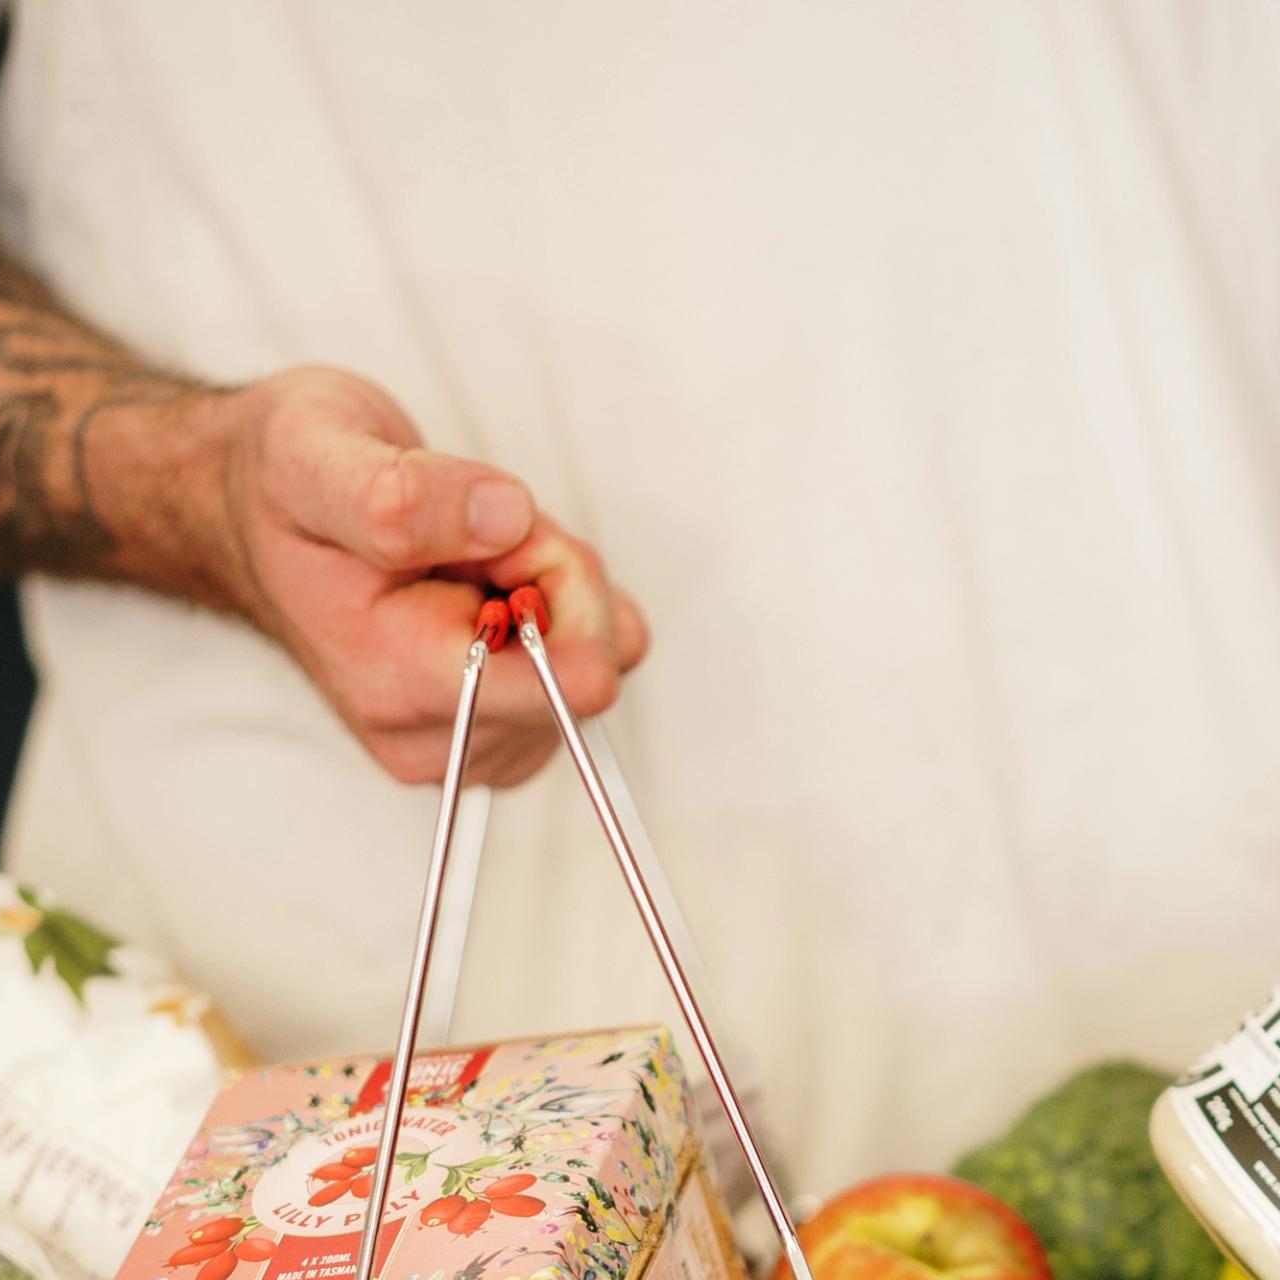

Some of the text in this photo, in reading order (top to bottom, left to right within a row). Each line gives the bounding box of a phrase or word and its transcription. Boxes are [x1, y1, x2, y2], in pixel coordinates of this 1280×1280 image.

[322, 1116, 457, 1147] TONIC WATER
[273, 1189, 421, 1229] LILLY PLY
[301, 1252, 352, 1267] 4 X 200ML
[308, 1268, 318, 1279] IN
[320, 1264, 358, 1278] TASMAN
